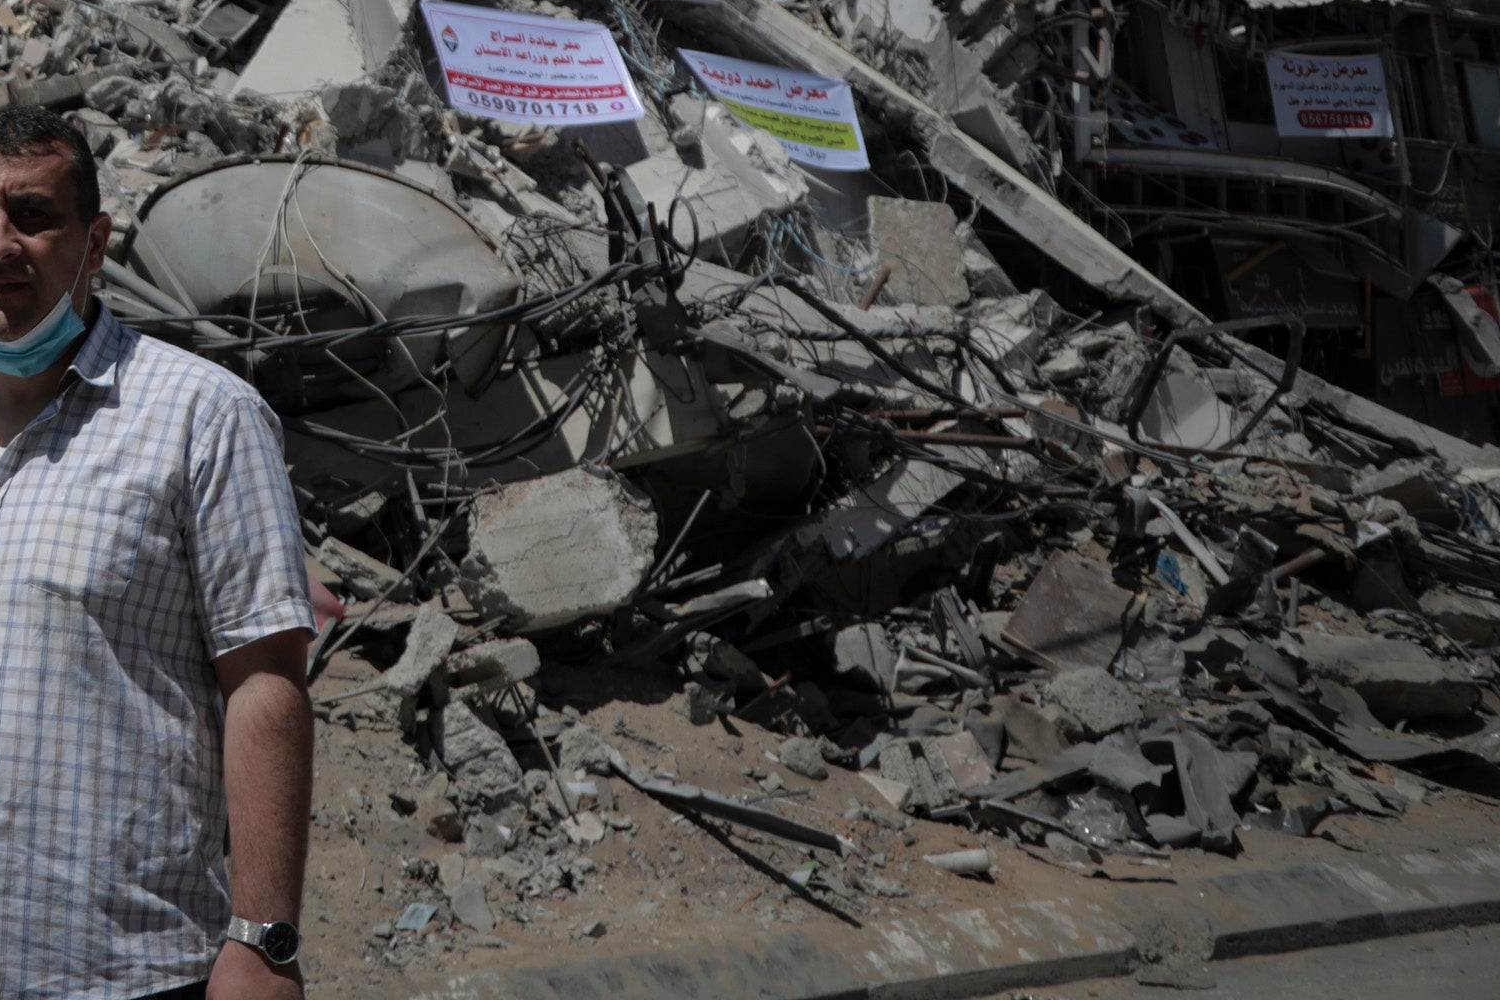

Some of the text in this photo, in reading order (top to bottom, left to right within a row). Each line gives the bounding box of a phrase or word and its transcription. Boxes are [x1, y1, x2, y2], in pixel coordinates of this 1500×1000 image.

[699, 59, 742, 87] دويمة
[1332, 61, 1369, 79] معرض
[785, 80, 829, 102] معرض
[468, 91, 598, 116] 0599701718
